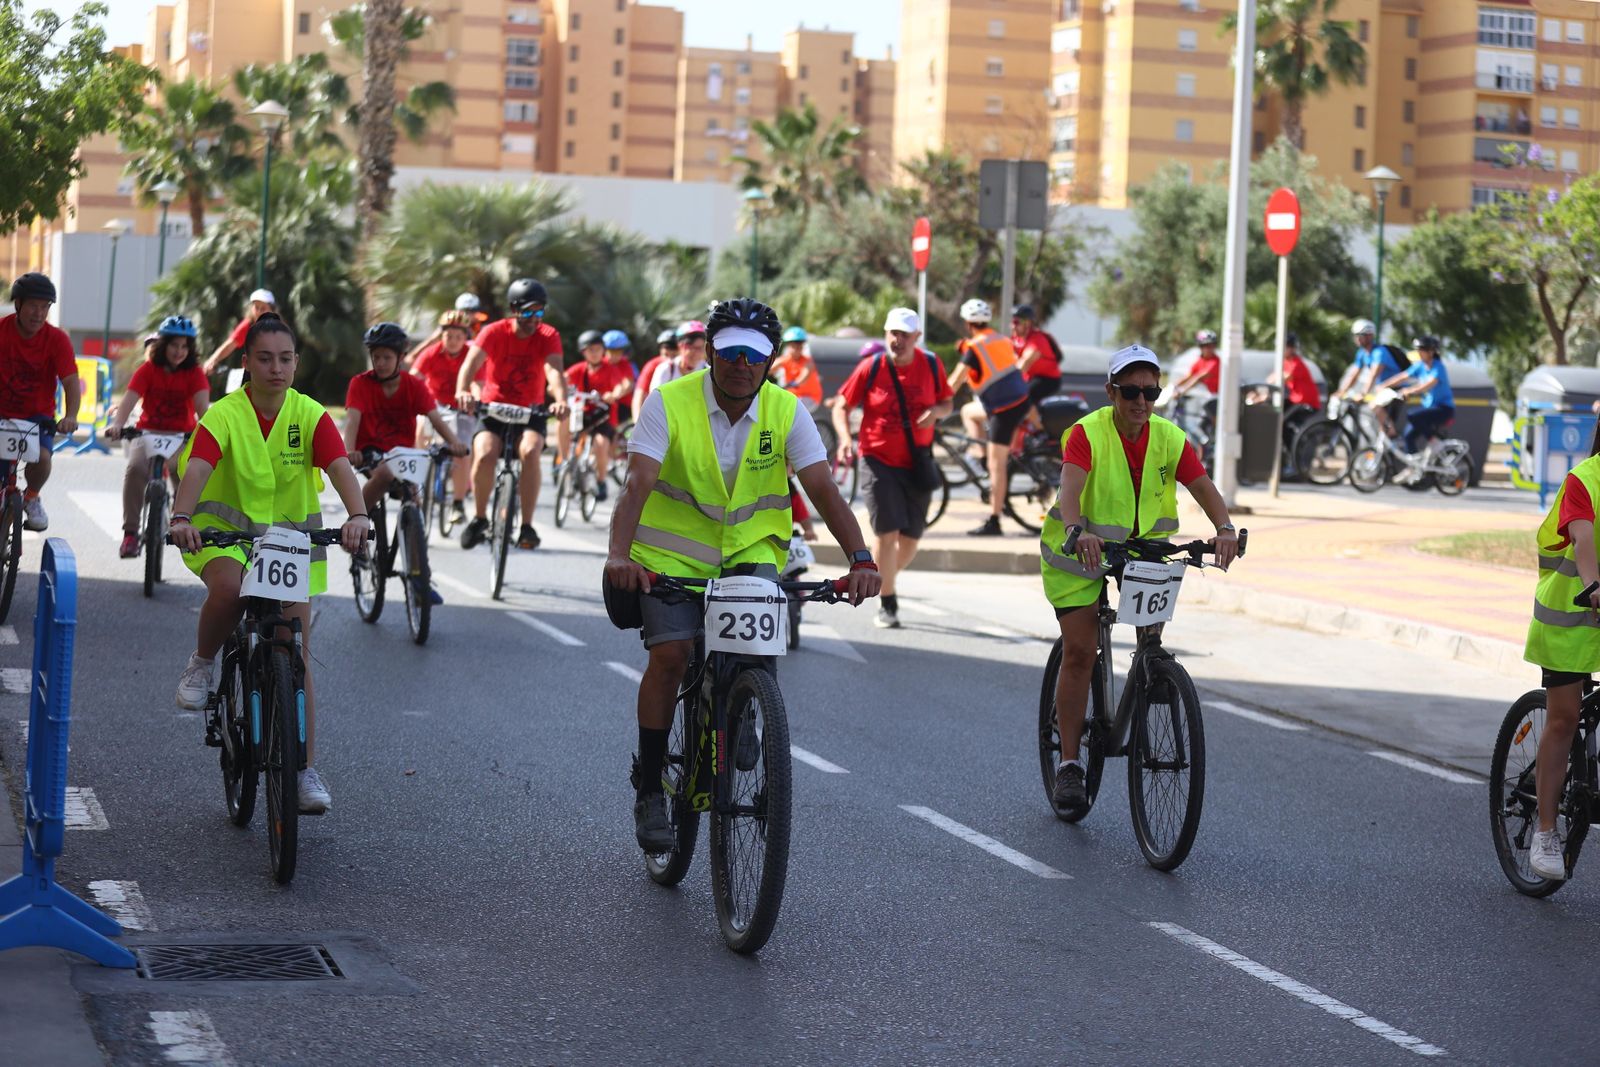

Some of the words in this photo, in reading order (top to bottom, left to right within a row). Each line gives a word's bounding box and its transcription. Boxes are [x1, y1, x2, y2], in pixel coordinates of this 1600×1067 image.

[7, 437, 28, 453] 30
[154, 438, 172, 450] 37
[398, 459, 417, 474] 36
[253, 557, 298, 588] 166
[1132, 589, 1170, 615] 165
[718, 612, 775, 641] 239
